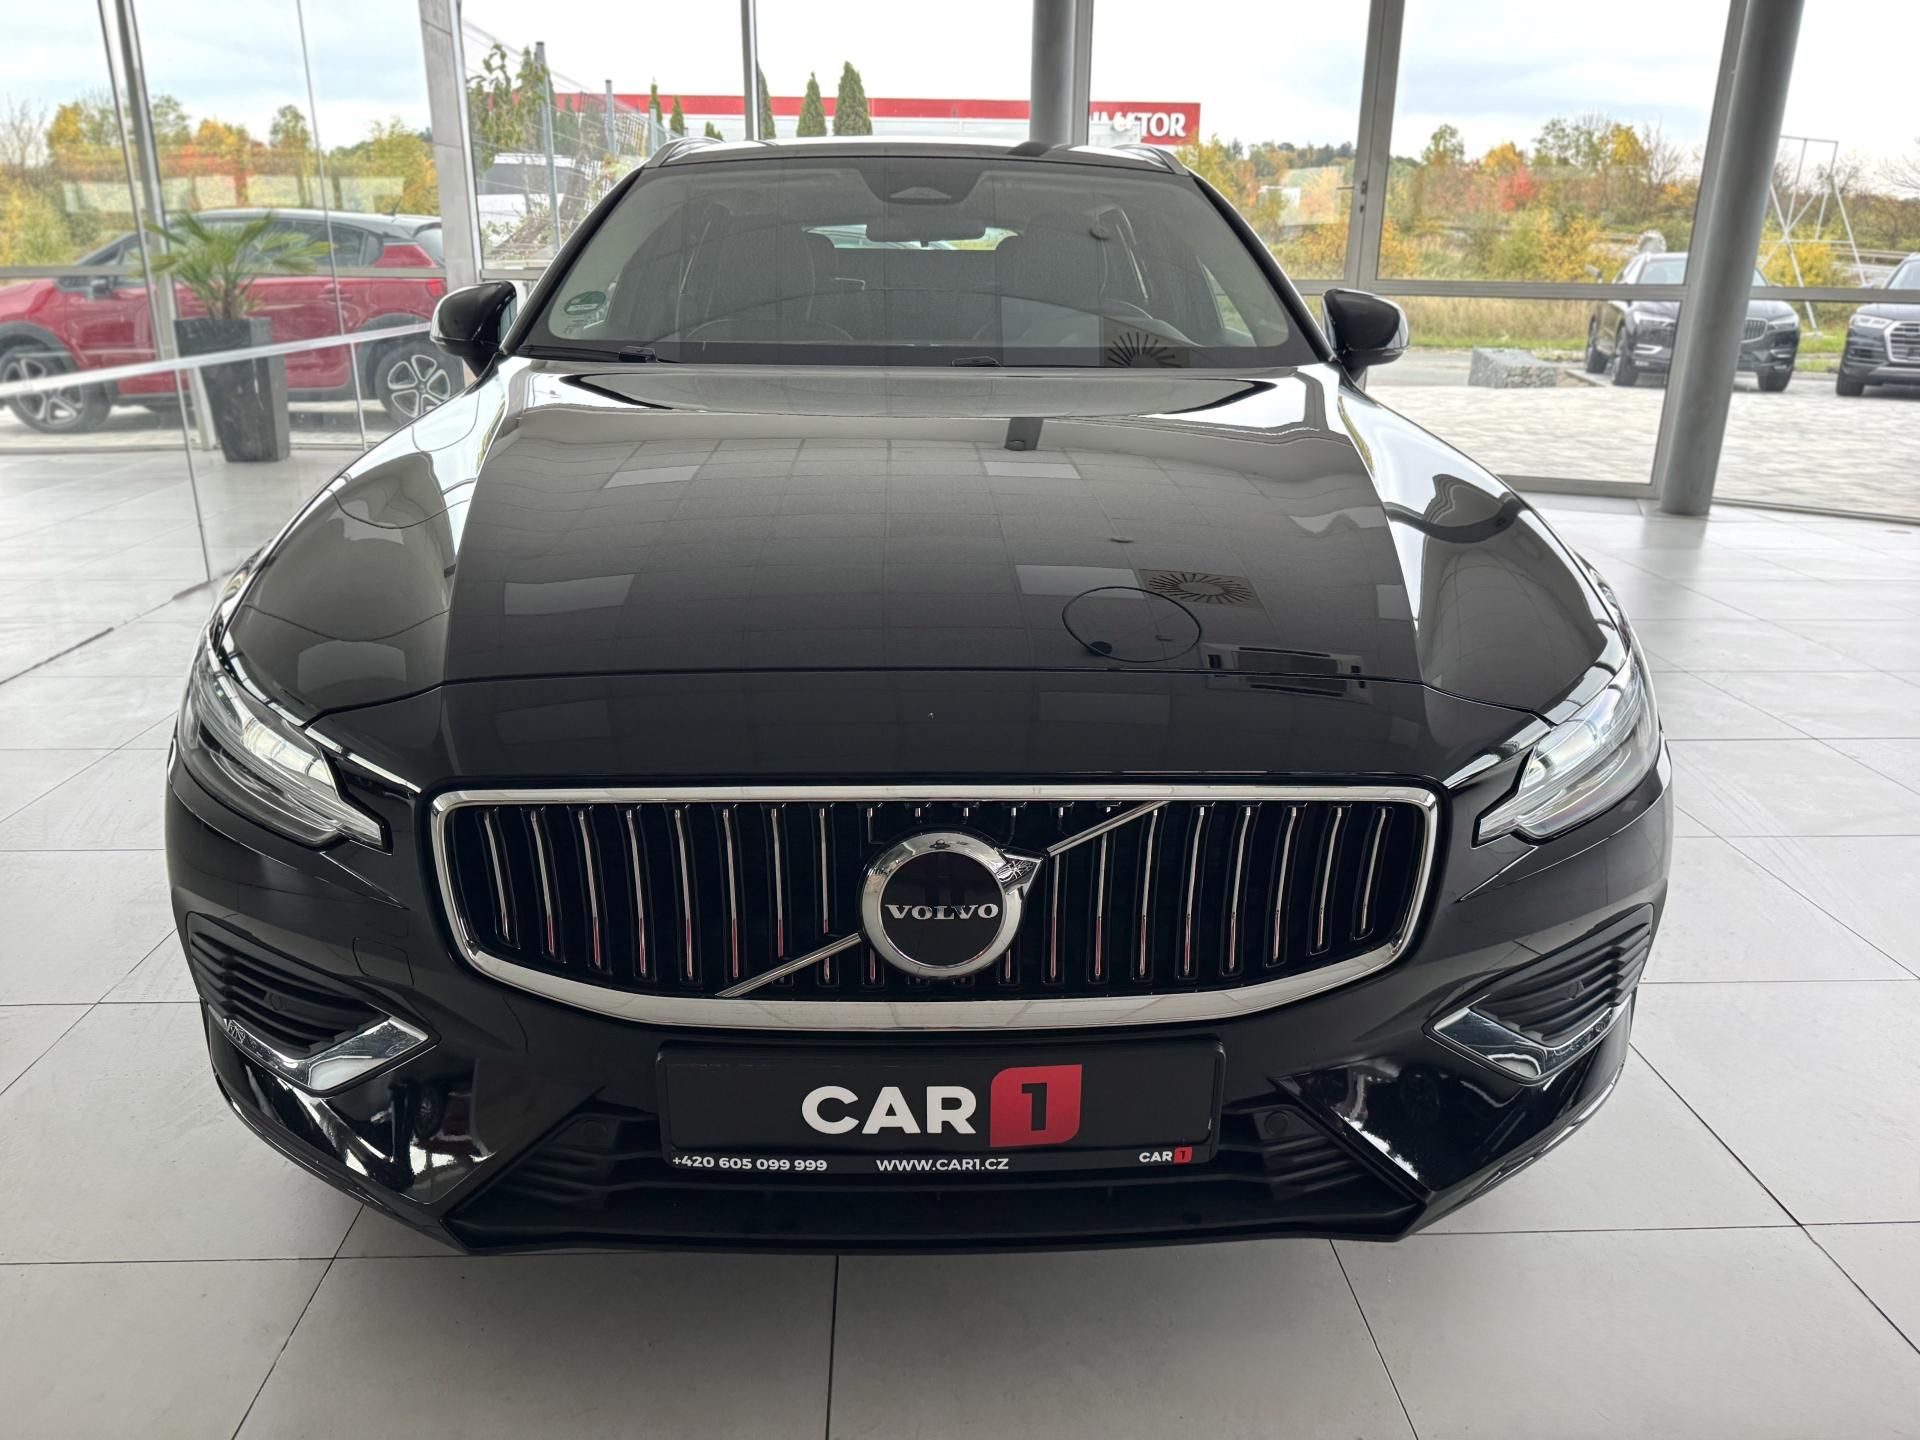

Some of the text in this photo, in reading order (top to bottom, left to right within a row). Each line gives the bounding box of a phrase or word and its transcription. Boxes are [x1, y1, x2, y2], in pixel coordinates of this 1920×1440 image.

[885, 903, 999, 920] VOLVO
[801, 1081, 1048, 1135] CAR 1
[672, 1155, 828, 1171] +420 605 099 999
[875, 1158, 1009, 1171] WWW.CAR1.CZ
[1138, 1150, 1173, 1163] CAR
